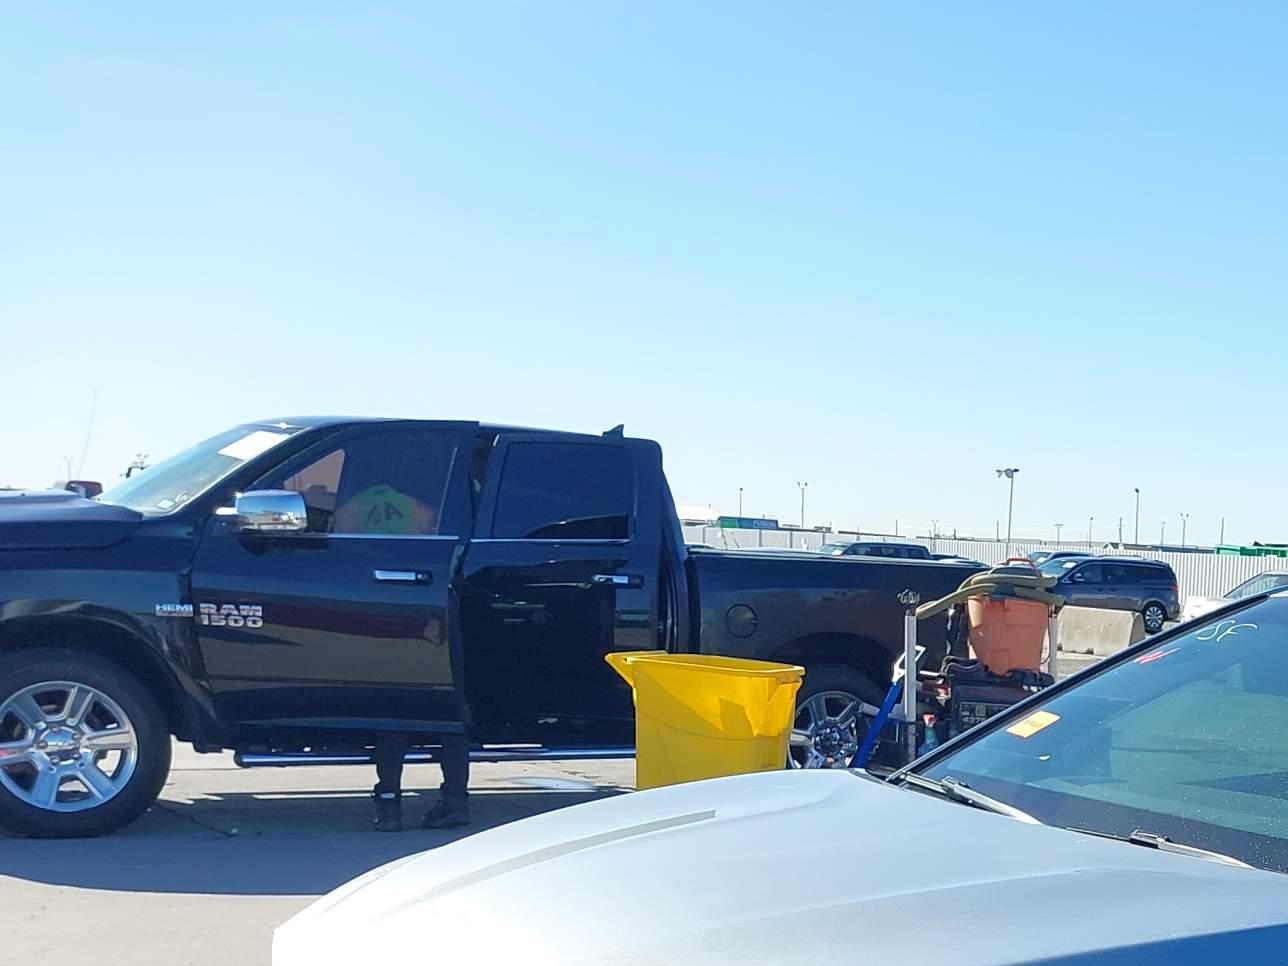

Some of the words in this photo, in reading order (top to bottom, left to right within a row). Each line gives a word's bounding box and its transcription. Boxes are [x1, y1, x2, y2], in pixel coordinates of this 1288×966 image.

[155, 603, 194, 613] HEMI
[199, 602, 263, 616] RAM
[200, 614, 263, 628] 1500
